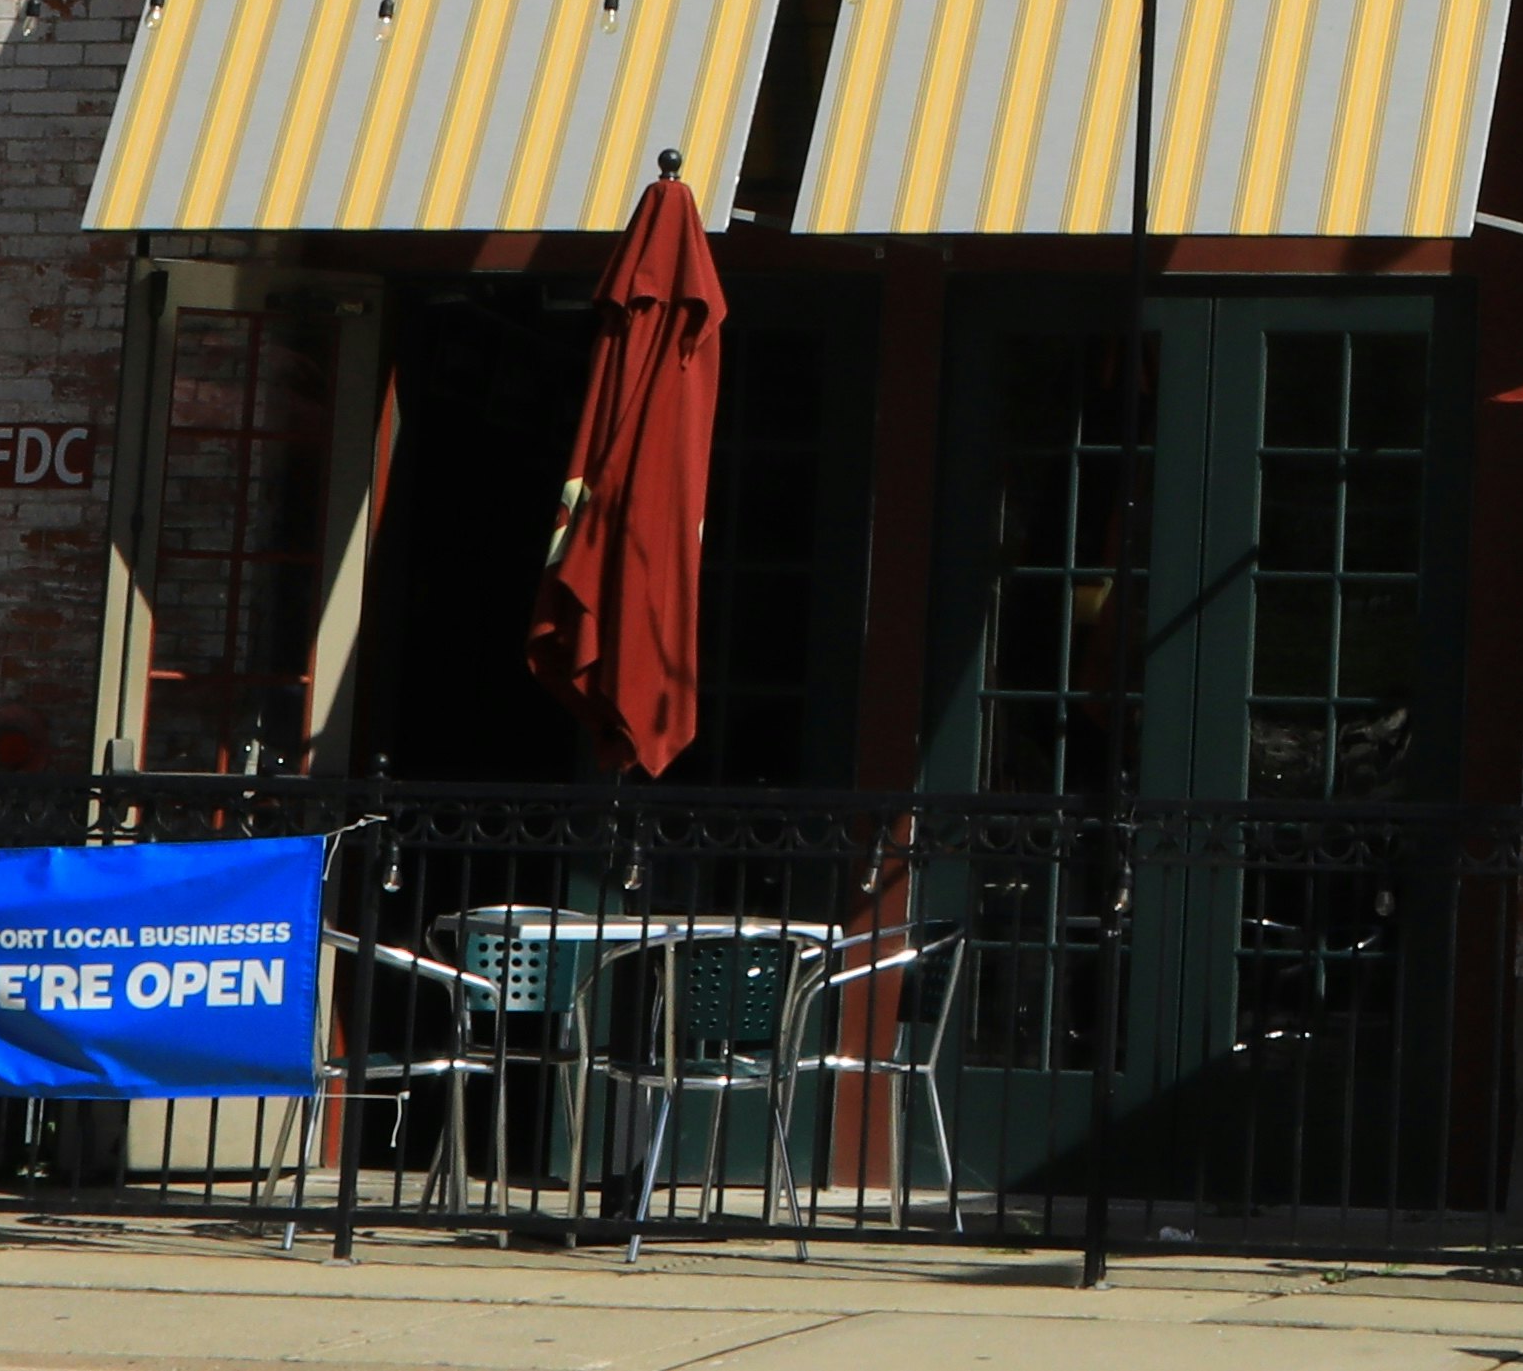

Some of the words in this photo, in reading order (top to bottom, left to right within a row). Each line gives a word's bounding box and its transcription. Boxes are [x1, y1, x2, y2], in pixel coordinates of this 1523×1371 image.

[53, 925, 134, 949] LOCAL
[139, 921, 291, 947] BUSINESSES
[126, 959, 285, 1007] OPEN
